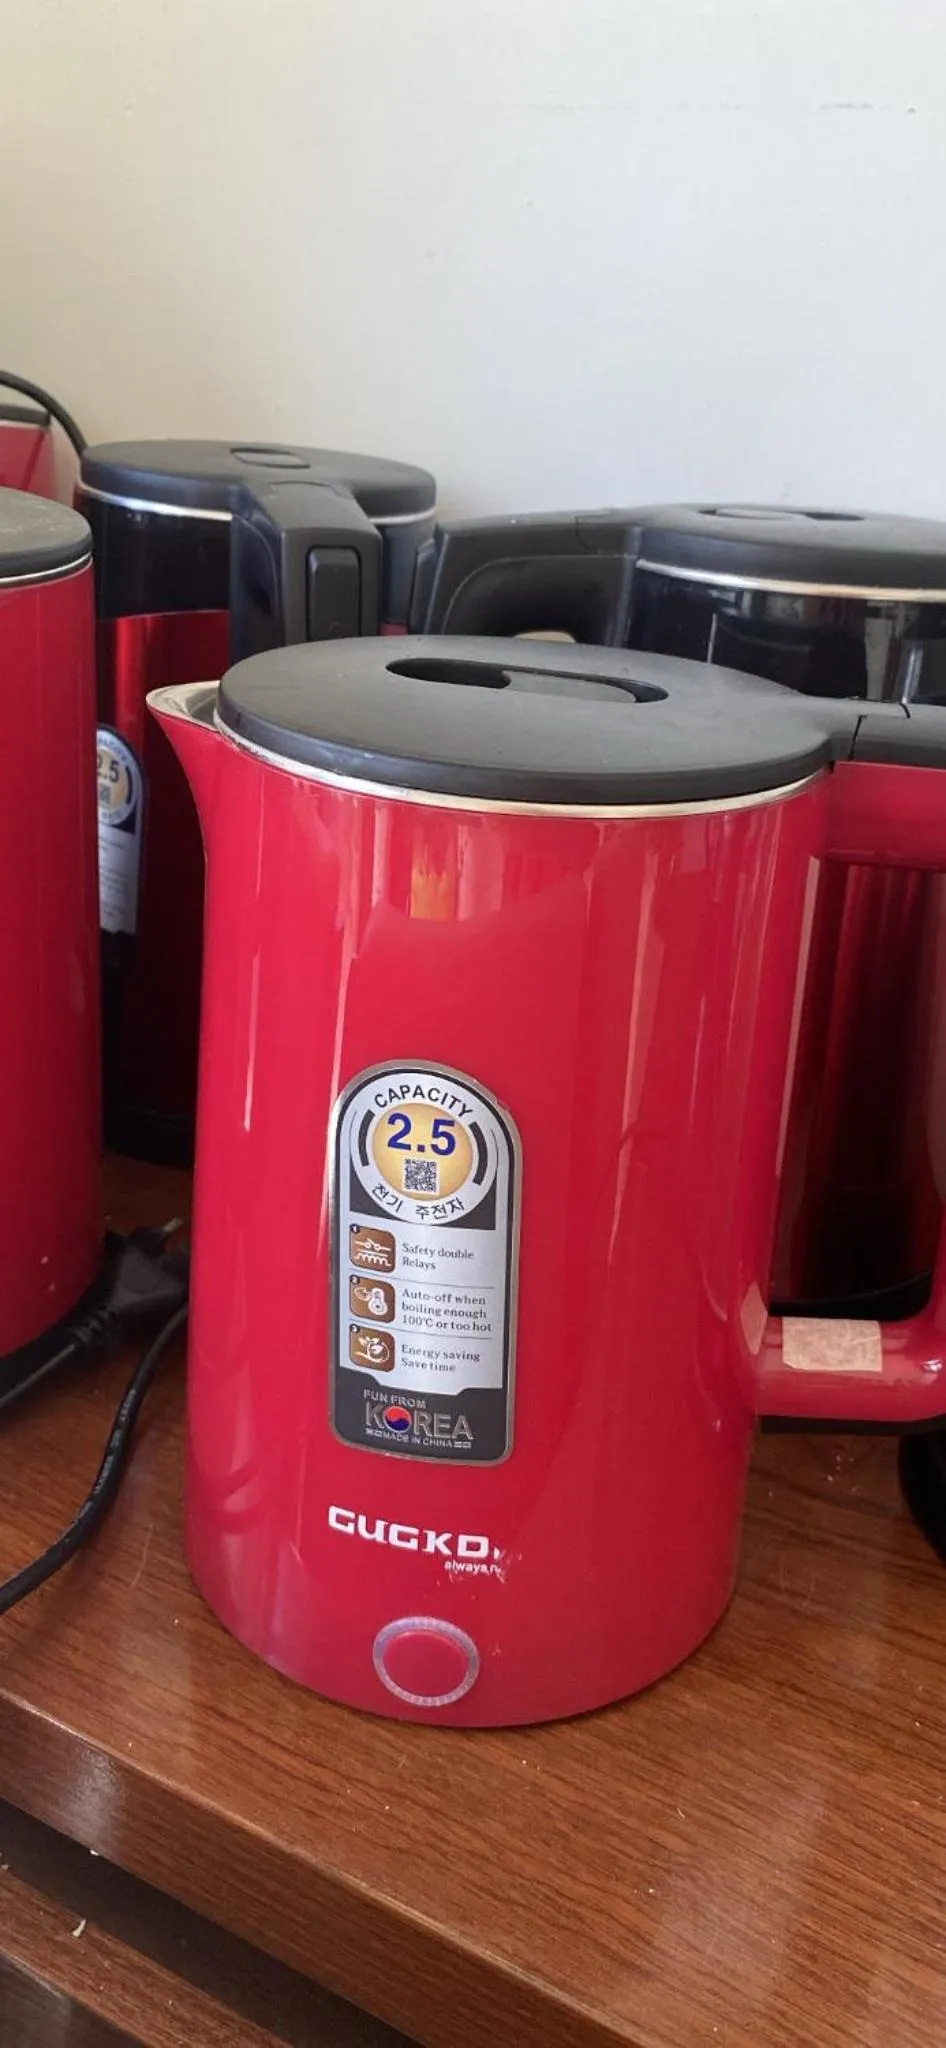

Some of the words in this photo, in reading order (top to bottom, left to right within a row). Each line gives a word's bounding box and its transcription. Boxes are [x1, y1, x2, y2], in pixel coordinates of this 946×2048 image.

[374, 1085, 473, 1117] CAPACITY
[387, 1112, 456, 1156] 2.5
[372, 1183, 403, 1213] 전기
[415, 1197, 465, 1220] 주전자
[402, 1243, 435, 1258] Safety
[438, 1248, 475, 1260] double
[402, 1257, 436, 1271] Relays
[402, 1289, 453, 1303] Auto-off
[455, 1295, 486, 1305] when
[402, 1302, 441, 1317] boiling
[443, 1308, 487, 1319] enough
[436, 1321, 448, 1329] or
[451, 1320, 470, 1331] too
[472, 1321, 492, 1332] hot
[401, 1344, 440, 1359] Energy
[443, 1351, 480, 1362] saving
[401, 1357, 428, 1369] Save
[430, 1360, 456, 1372] time
[391, 1395, 426, 1409] FROM
[365, 1401, 475, 1440] KOREA
[384, 1432, 409, 1443] MADE
[411, 1436, 420, 1444] IN
[422, 1438, 453, 1448] CHINA
